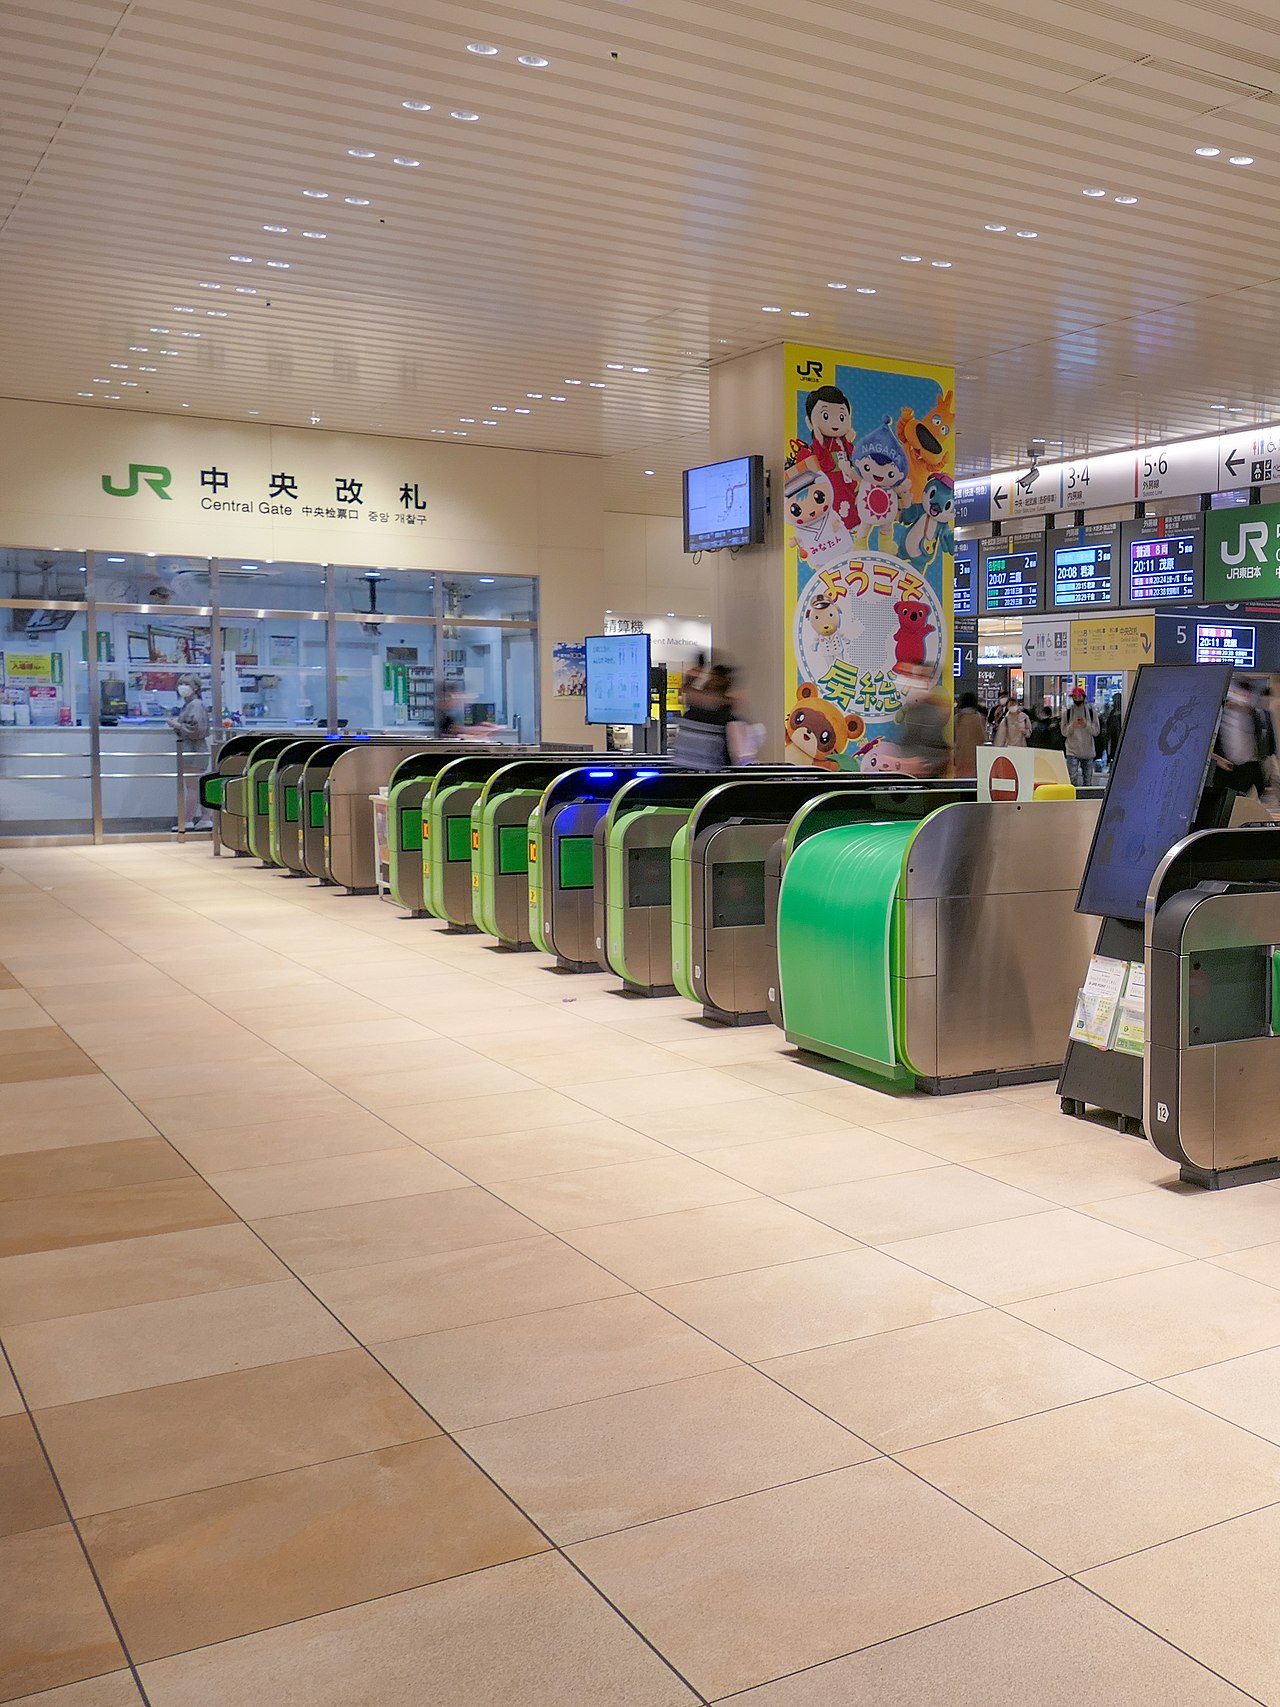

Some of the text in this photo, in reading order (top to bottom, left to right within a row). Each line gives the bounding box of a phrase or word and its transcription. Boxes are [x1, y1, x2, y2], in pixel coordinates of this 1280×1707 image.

[797, 360, 822, 378] JR
[101, 463, 173, 501] JR
[200, 497, 293, 516] Central Gate
[367, 510, 428, 526] 중앙 개찰구
[810, 536, 842, 555] みなたん
[1221, 521, 1268, 565] JR
[1057, 566, 1077, 580] 20:08
[1133, 559, 1154, 573] 20:11
[1226, 566, 1262, 580] JR東日本
[819, 560, 924, 601] ようこそ
[988, 573, 1006, 585] 20:07
[1176, 625, 1187, 644] 5
[1199, 638, 1220, 647] 20:11
[964, 649, 974, 663] 4
[818, 658, 908, 712] 房総
[1158, 1107, 1167, 1118] 12
